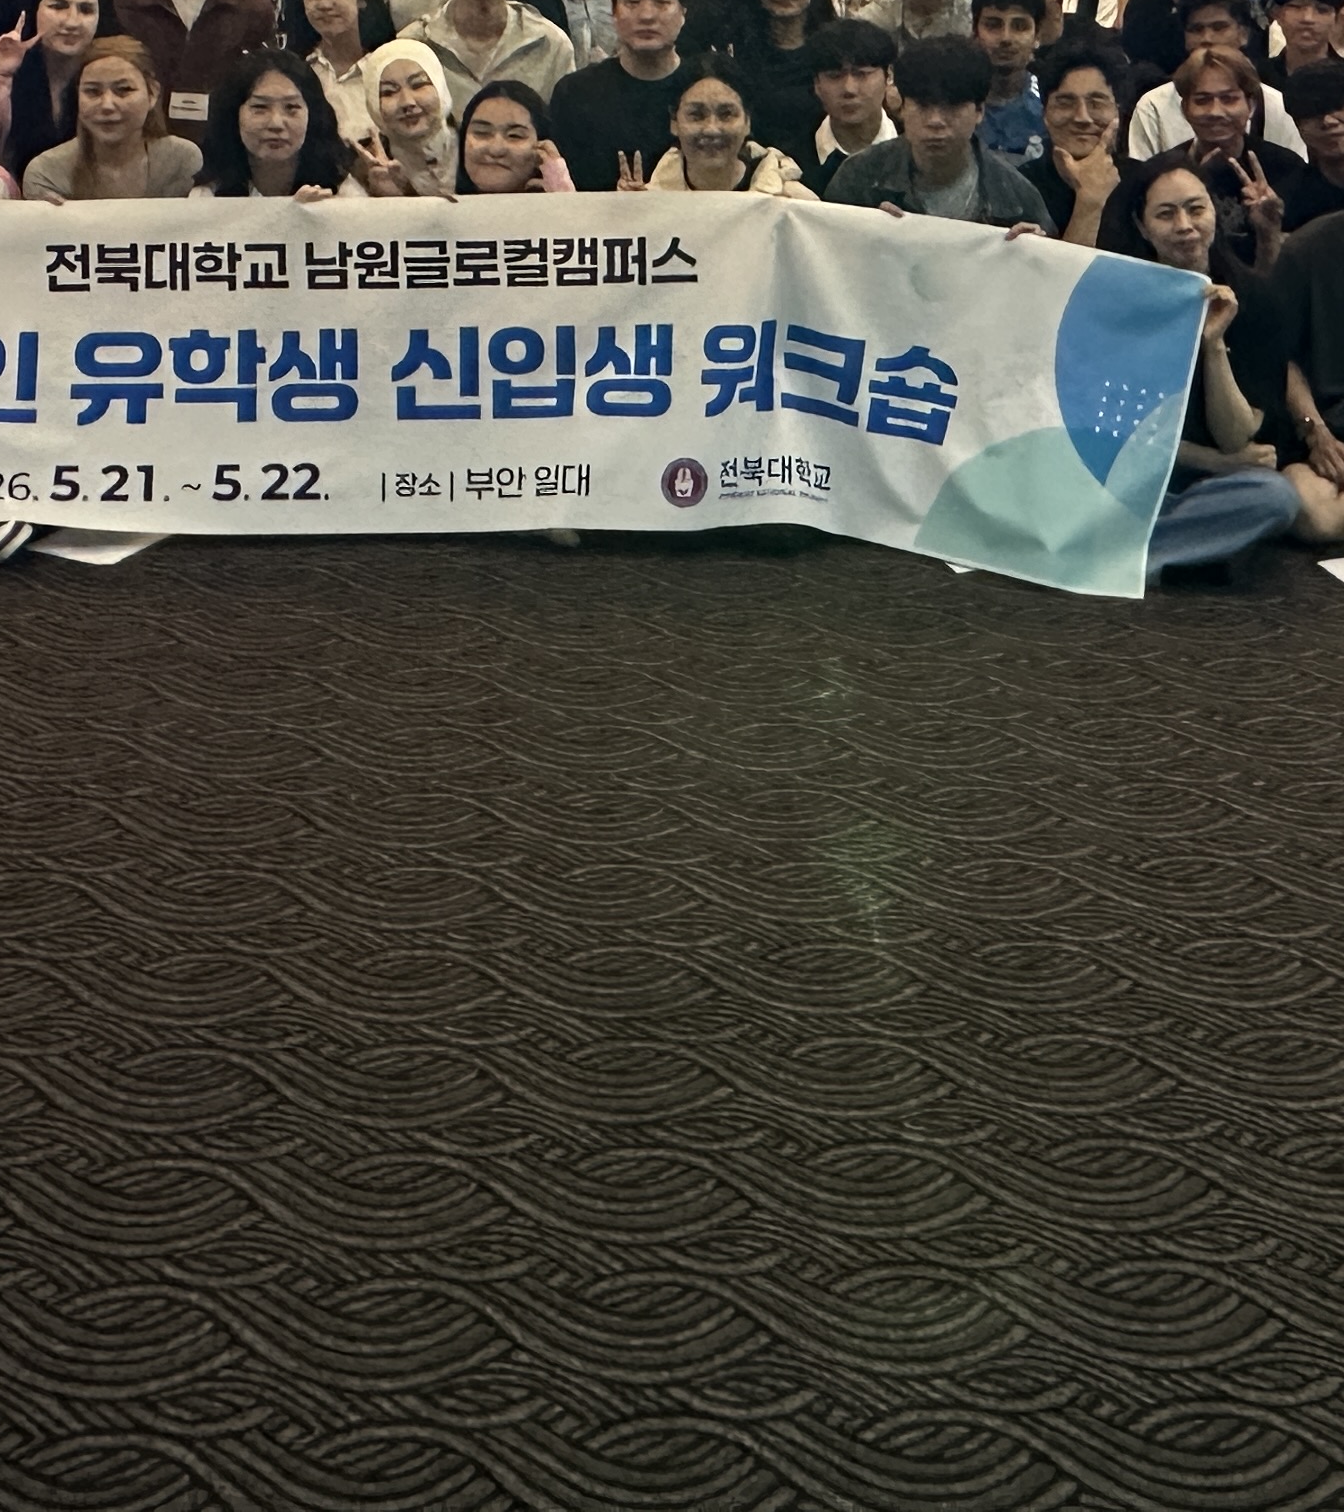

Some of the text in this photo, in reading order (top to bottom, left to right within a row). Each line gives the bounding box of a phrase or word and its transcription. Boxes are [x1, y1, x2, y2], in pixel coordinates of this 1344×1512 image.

[44, 236, 699, 293] 전북대학교 남원글로컬캠퍼스
[69, 327, 359, 427] 유학생
[390, 323, 674, 421] 신입생
[700, 318, 959, 447] 워크숍
[465, 466, 527, 501] 부안
[534, 463, 591, 498] 일대
[719, 455, 832, 492] 전북대학교
